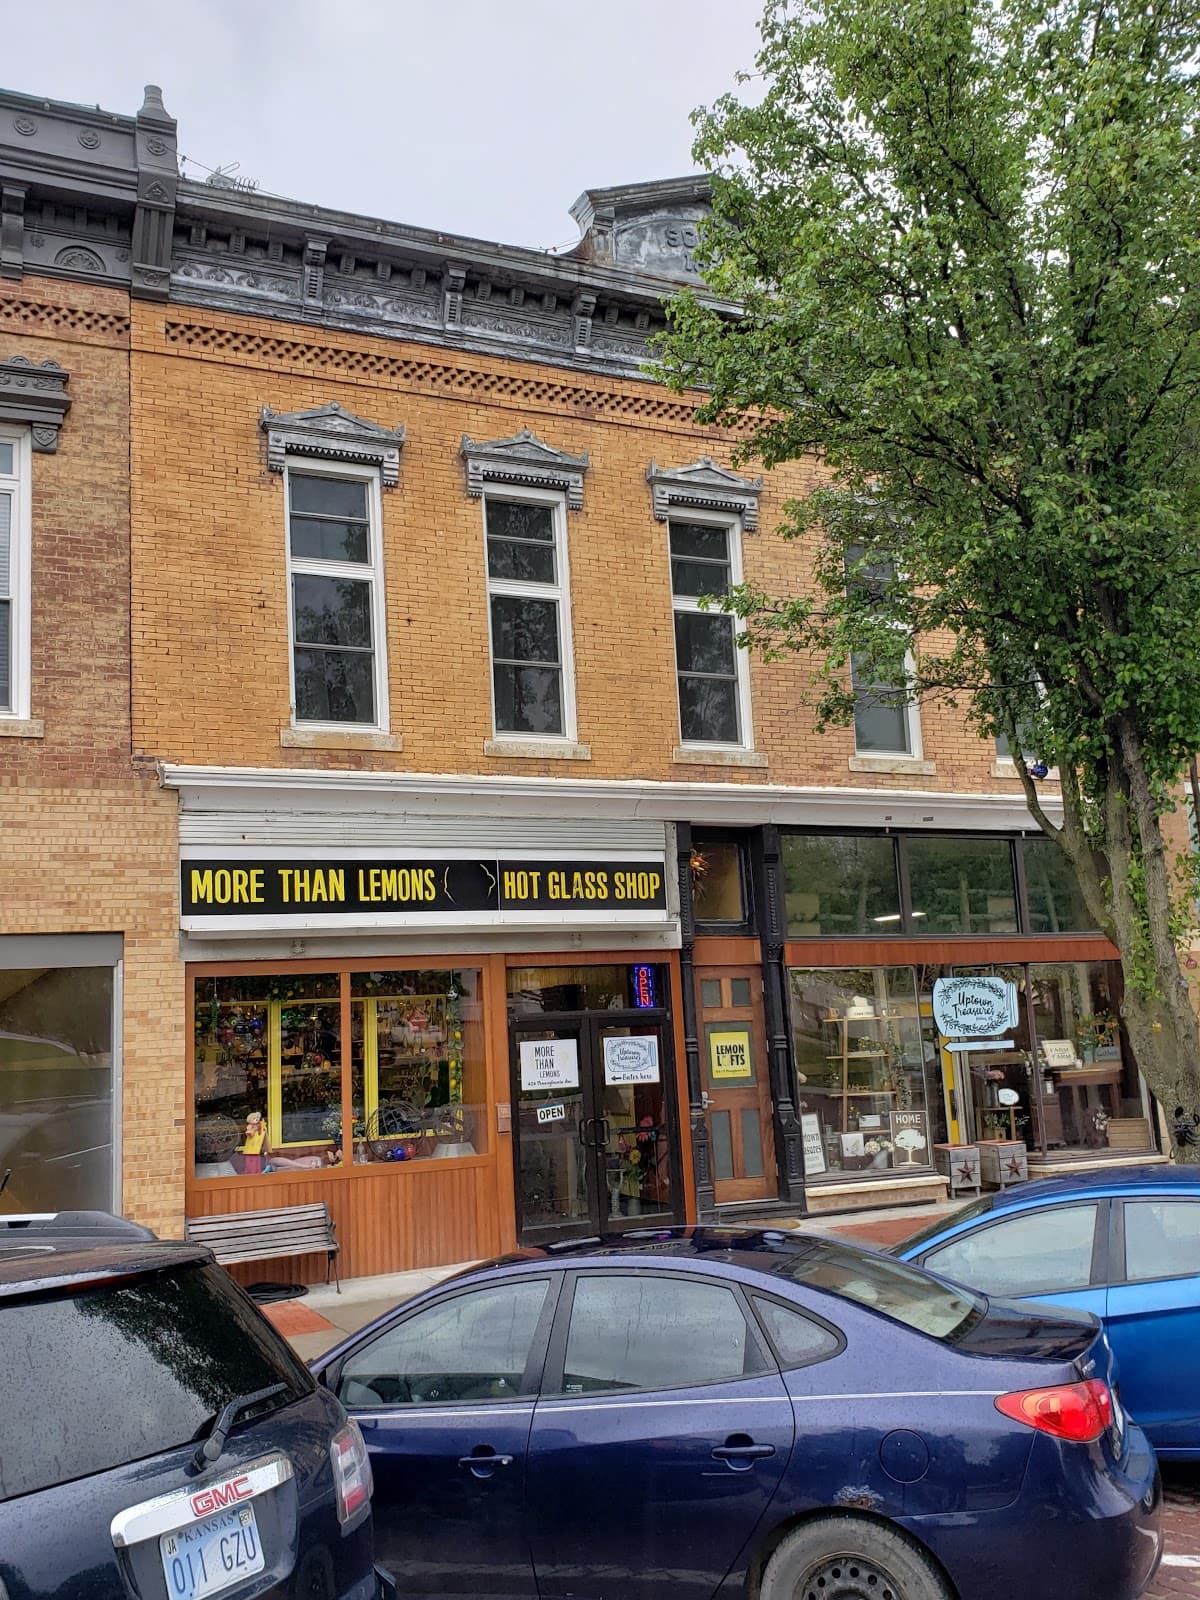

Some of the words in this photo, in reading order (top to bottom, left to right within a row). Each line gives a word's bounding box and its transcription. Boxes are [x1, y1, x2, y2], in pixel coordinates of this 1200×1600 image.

[190, 869, 265, 904] MORE
[278, 869, 344, 904] THAN
[358, 869, 436, 902] LEMONS
[504, 871, 540, 900] HOT
[548, 872, 609, 900] GLASS
[614, 873, 661, 900] SHOP
[639, 969, 649, 1006] OPEN
[958, 991, 994, 1007] Uptown
[952, 1003, 994, 1019] Treasures
[534, 1046, 555, 1057] MORE
[716, 1044, 745, 1055] LEMON
[535, 1058, 555, 1070] THAN
[540, 1070, 561, 1079] LEMONS
[539, 1107, 564, 1120] OPEN
[895, 1114, 921, 1125] HOME
[191, 1476, 253, 1517] GMC
[184, 1513, 234, 1543] KANSAS
[168, 1539, 177, 1555] JA
[173, 1546, 208, 1594] 011
[220, 1526, 257, 1572] GZU
